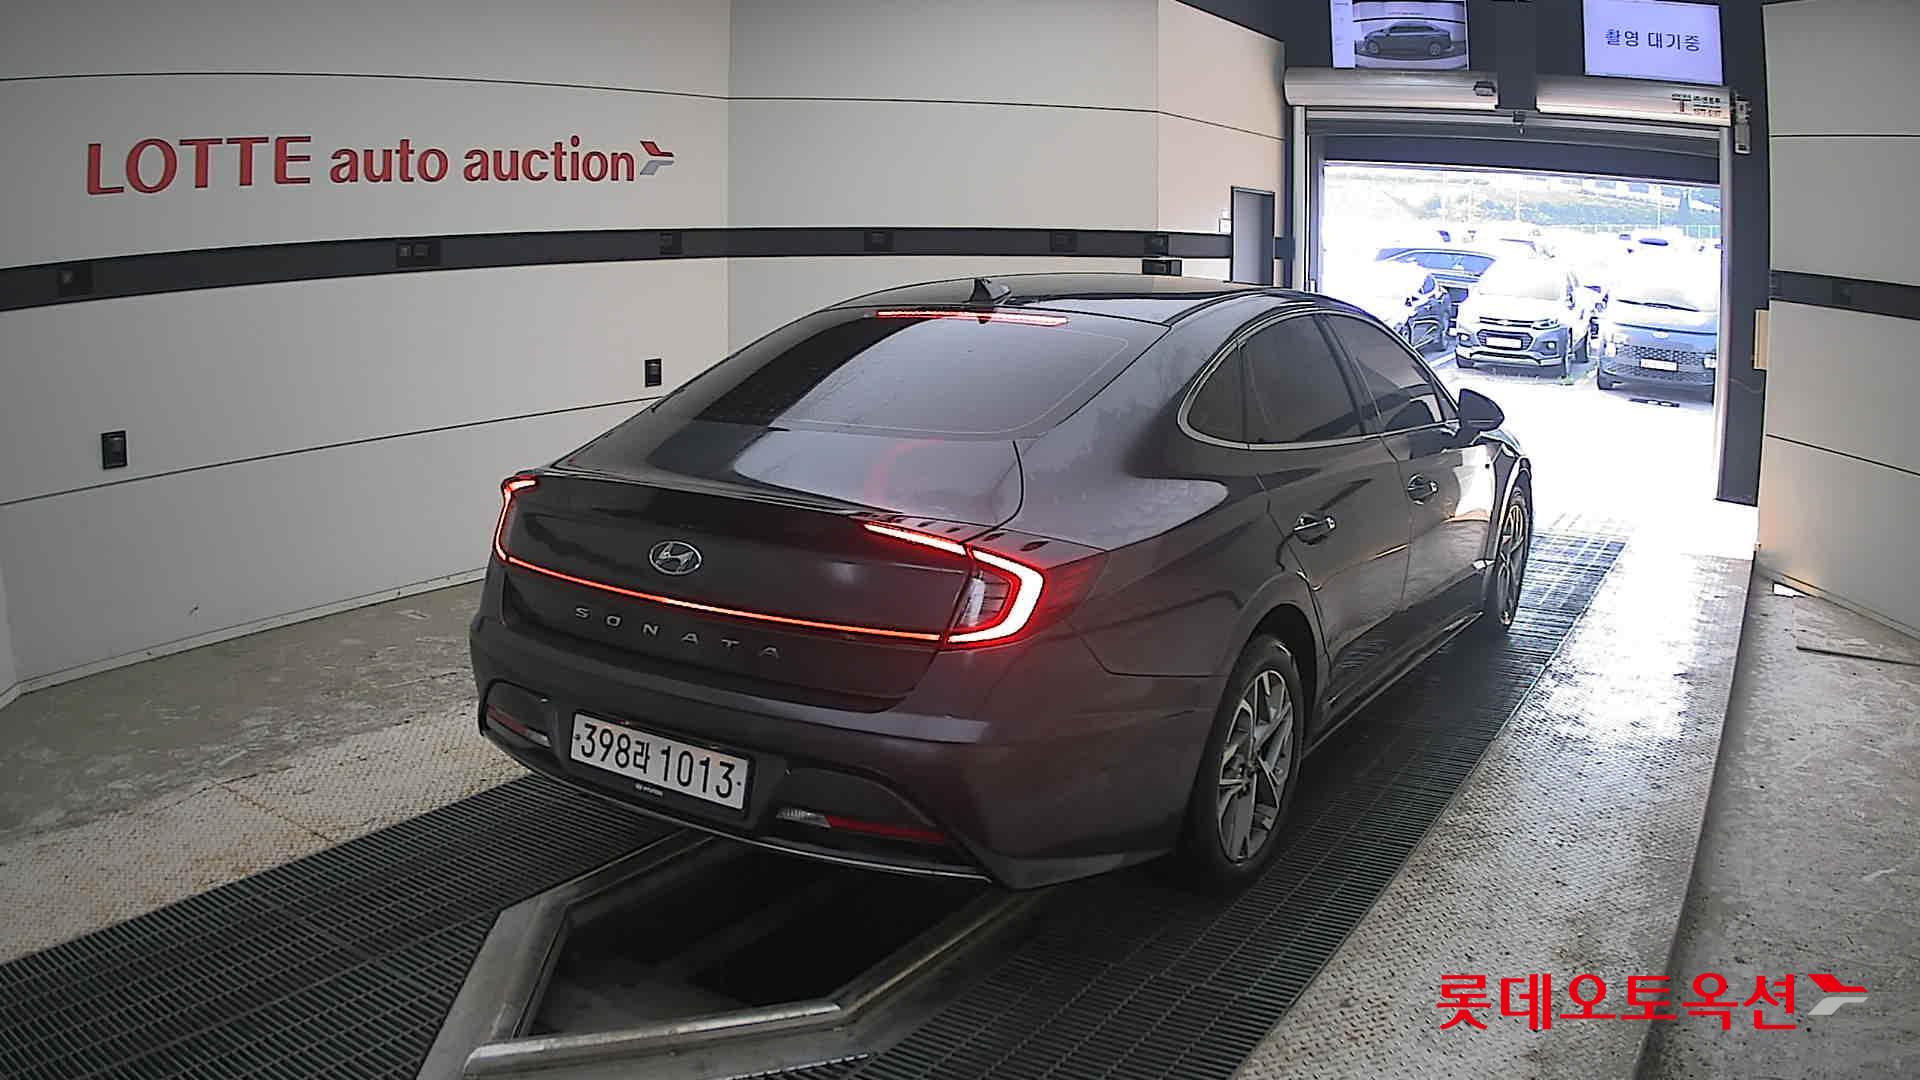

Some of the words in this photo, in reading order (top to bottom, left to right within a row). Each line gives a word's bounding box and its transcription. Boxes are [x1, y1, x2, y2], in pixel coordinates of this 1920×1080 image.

[1647, 31, 1701, 52] 대기중
[86, 136, 312, 195] LOTTE
[329, 138, 449, 183] auto
[463, 135, 635, 182] auction
[575, 606, 780, 659] SONATA
[581, 722, 650, 774] 398라
[660, 745, 736, 799] 1013
